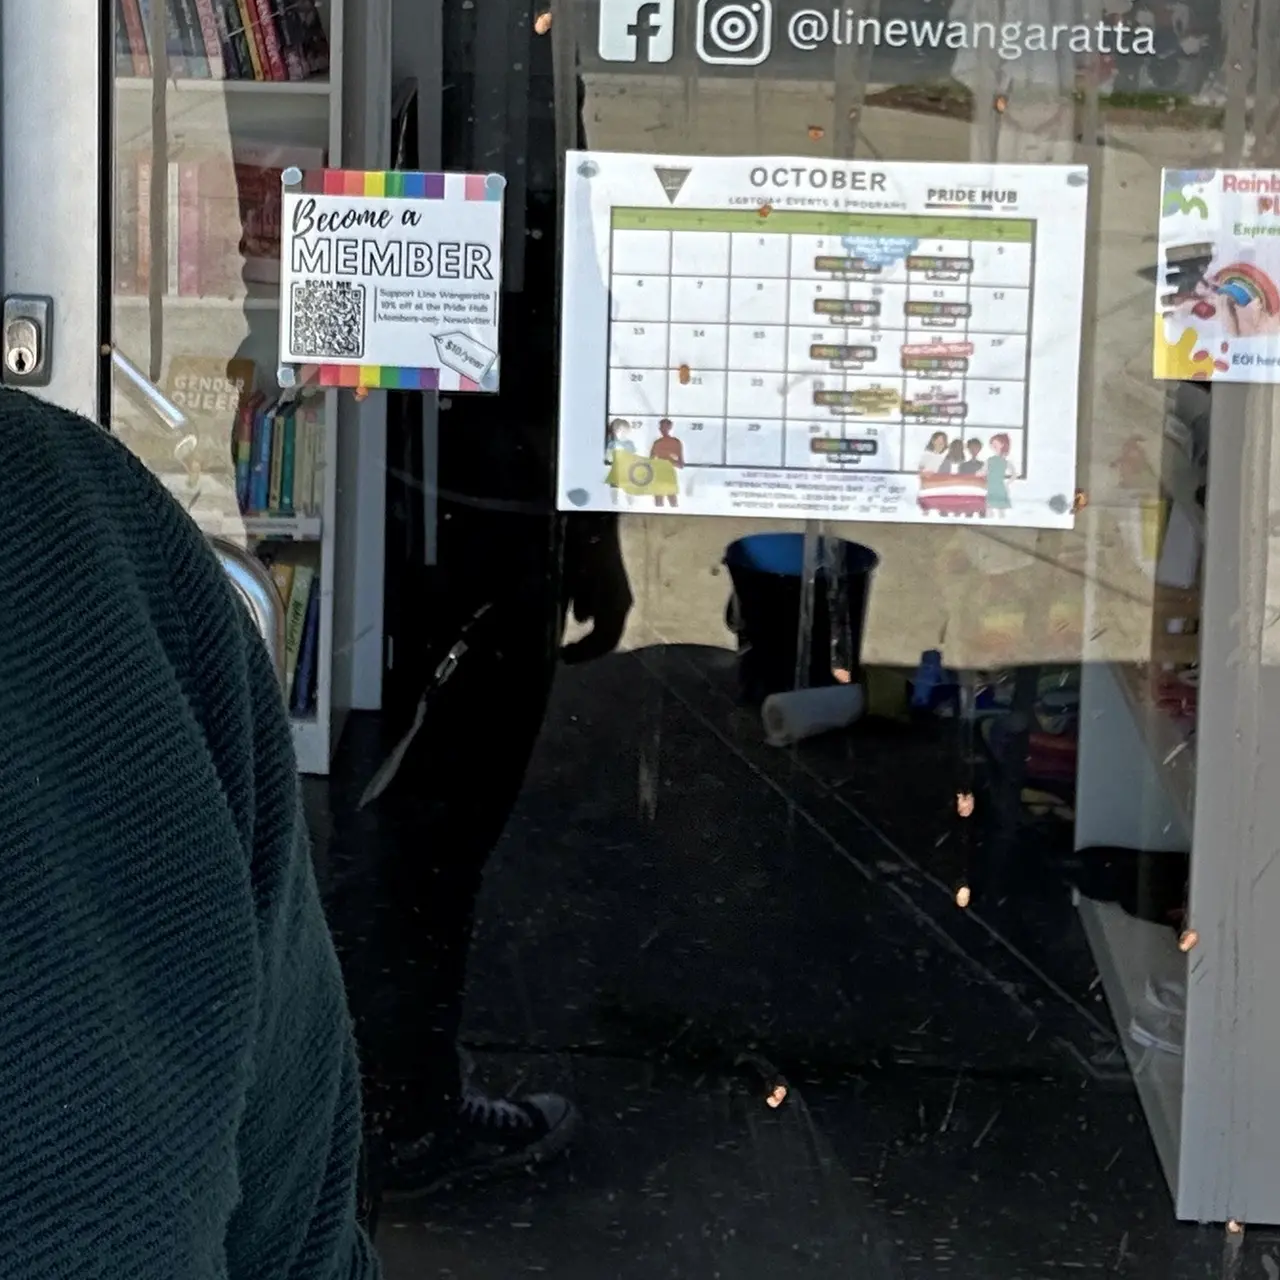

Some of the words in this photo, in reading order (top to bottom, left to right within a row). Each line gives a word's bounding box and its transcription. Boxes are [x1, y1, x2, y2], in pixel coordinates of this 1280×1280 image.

[787, 8, 1157, 58] @linewangaratta
[750, 167, 887, 191] OCTOBER
[927, 188, 977, 202] PRIDE
[980, 190, 1019, 203] HUB
[291, 198, 394, 238] Become
[401, 209, 422, 227] a
[291, 236, 494, 280] MEMBER
[305, 279, 333, 289] SCAN
[335, 280, 352, 290] ME
[399, 301, 413, 309] off
[426, 303, 441, 311] the
[443, 303, 466, 312] Pride
[468, 304, 489, 313] Hub
[445, 340, 484, 369] $10/year
[1232, 353, 1254, 367] EOI
